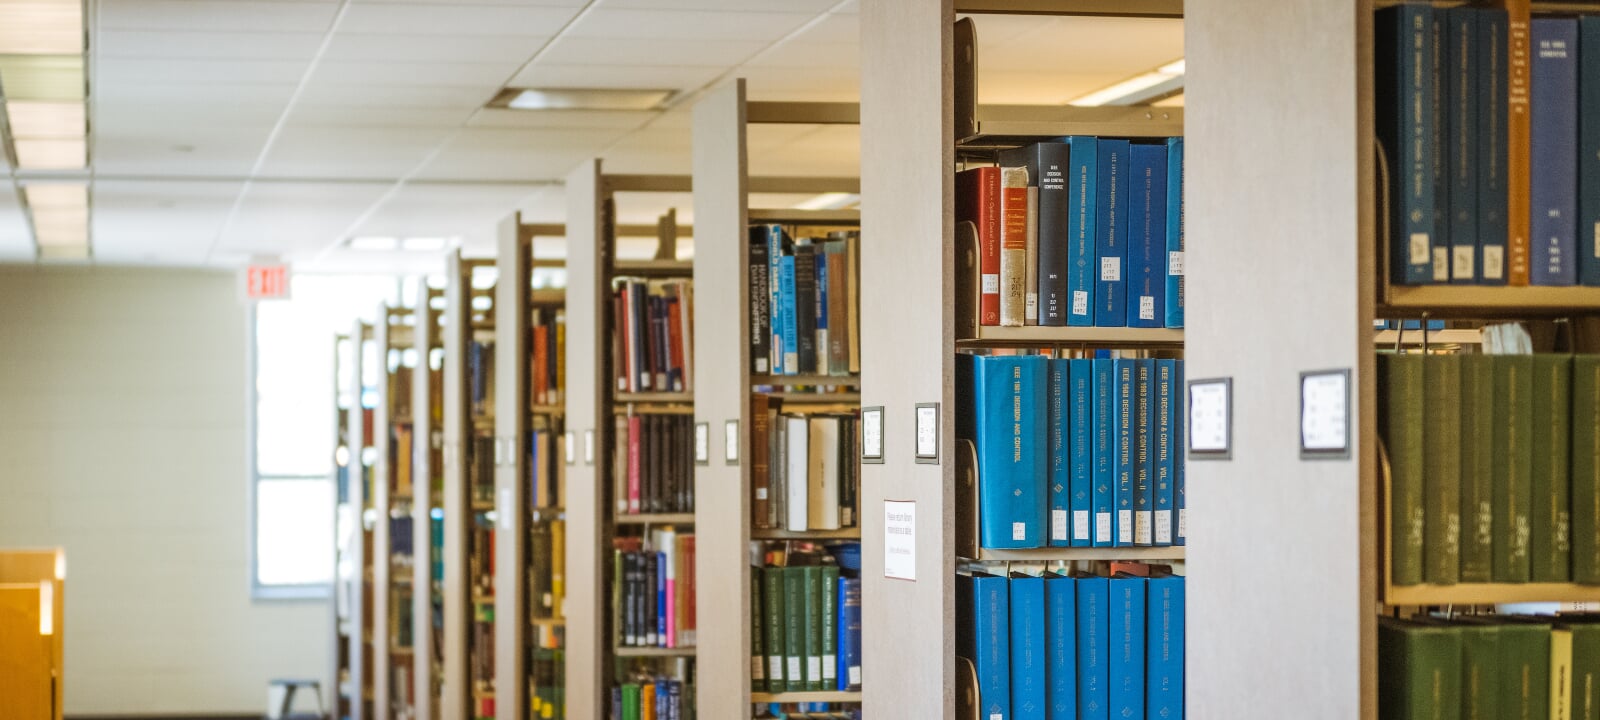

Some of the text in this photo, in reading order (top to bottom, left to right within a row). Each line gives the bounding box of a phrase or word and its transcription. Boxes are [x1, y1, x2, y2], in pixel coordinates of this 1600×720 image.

[248, 265, 286, 298] EXIT
[758, 264, 768, 328] HANDBOOK OF
[752, 286, 760, 344] ENGINEERING
